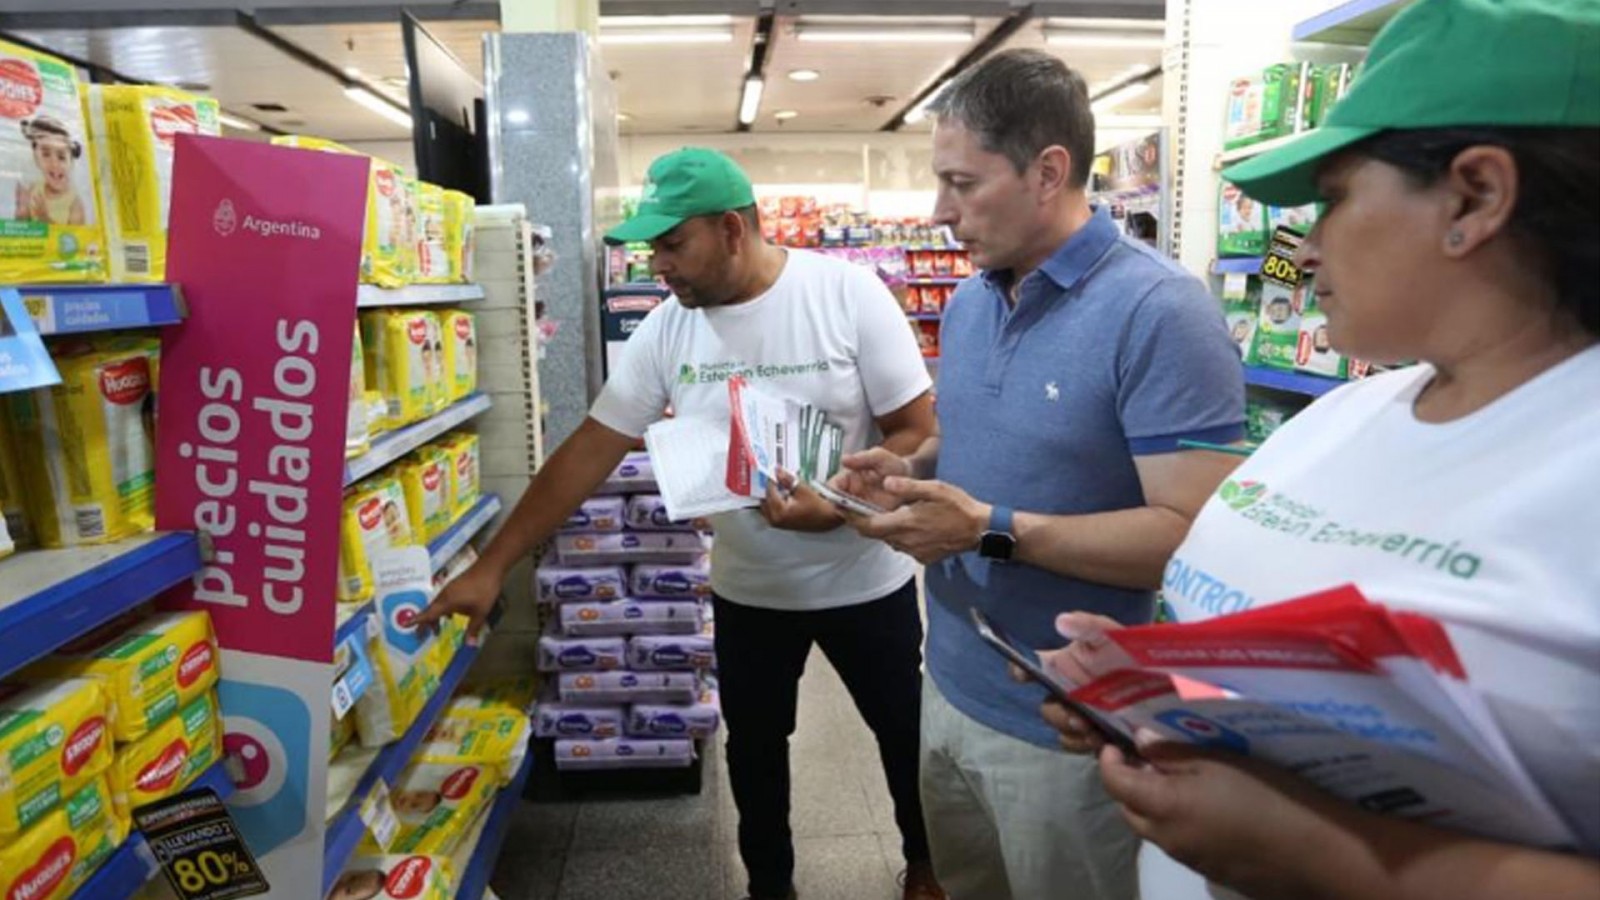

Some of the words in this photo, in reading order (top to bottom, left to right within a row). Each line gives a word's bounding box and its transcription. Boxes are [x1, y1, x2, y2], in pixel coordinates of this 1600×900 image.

[243, 215, 321, 240] Argentina
[1264, 256, 1297, 280] 80%
[248, 319, 319, 614] cuidados
[174, 851, 249, 892] 80%
